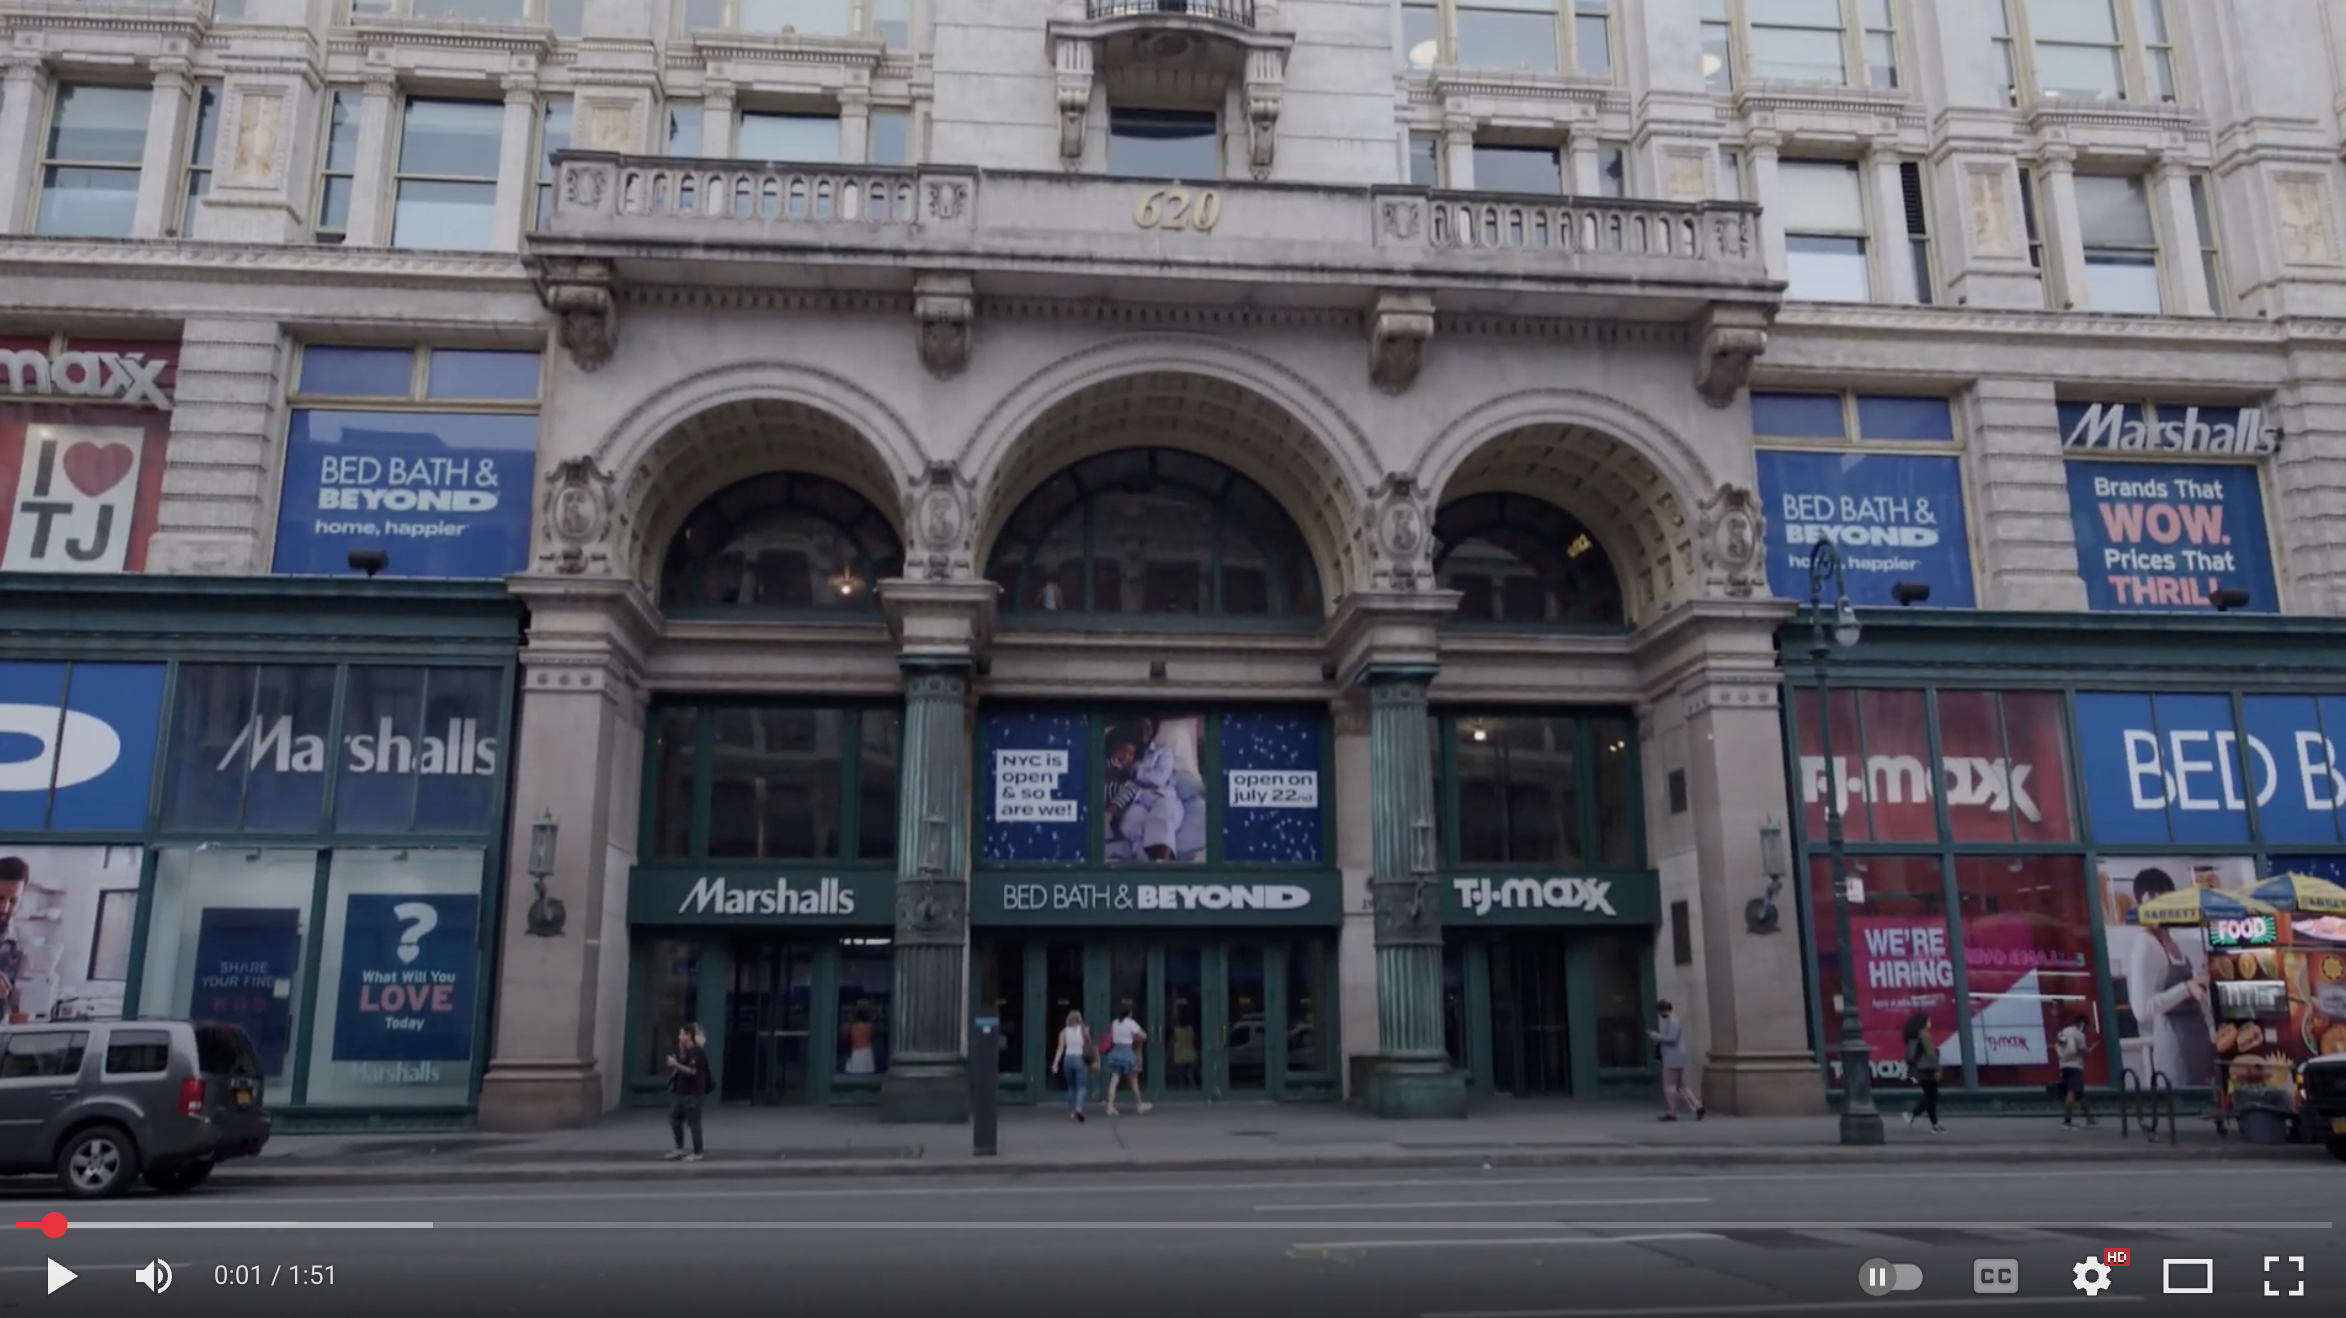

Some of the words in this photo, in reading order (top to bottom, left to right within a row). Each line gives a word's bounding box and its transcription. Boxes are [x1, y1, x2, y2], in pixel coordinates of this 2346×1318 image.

[1134, 190, 1221, 232] 620
[2064, 403, 2278, 454] Marshalls
[321, 457, 380, 485] BED
[389, 458, 469, 486] BATH
[475, 459, 499, 486] &
[2094, 477, 2168, 498] Brands
[2174, 479, 2224, 499] That
[318, 489, 498, 511] BEYOND
[1782, 494, 1835, 521] BED
[1840, 496, 1910, 523] BATH
[1915, 498, 1937, 524] &
[20, 502, 113, 561] TJ
[315, 519, 379, 536] home,
[384, 519, 467, 538] happier
[1786, 524, 1939, 547] BEYOND
[2099, 503, 2231, 545] WOW.
[1848, 557, 1917, 573] happier
[2104, 548, 2176, 571] Prices
[2182, 550, 2236, 572] That
[217, 714, 497, 775] Mashalls
[1002, 754, 1043, 767] NYC
[1047, 754, 1063, 767] is
[2124, 729, 2278, 811] BED
[1001, 772, 1053, 785] open
[1233, 775, 1285, 788] open
[1288, 775, 1313, 786] on
[1001, 787, 1016, 799] &
[1021, 789, 1045, 799] so
[1230, 788, 1268, 804] july
[1001, 805, 1034, 816] are
[1038, 804, 1072, 816] we!
[679, 877, 855, 915] Marshalls
[1003, 884, 1047, 910] BED
[1054, 884, 1111, 910] BATH
[1115, 884, 1133, 910] &
[1137, 885, 1311, 910] BEYOND
[2217, 916, 2267, 940] FOOD
[1864, 928, 1945, 957] WE'RE
[220, 961, 269, 975] SHARE
[363, 970, 397, 983] What
[402, 970, 427, 983] Will
[431, 970, 456, 983] You
[1869, 960, 1954, 988] HIRING
[202, 975, 242, 989] YOUR
[359, 984, 454, 1013] LOVE
[385, 1016, 425, 1031] Today
